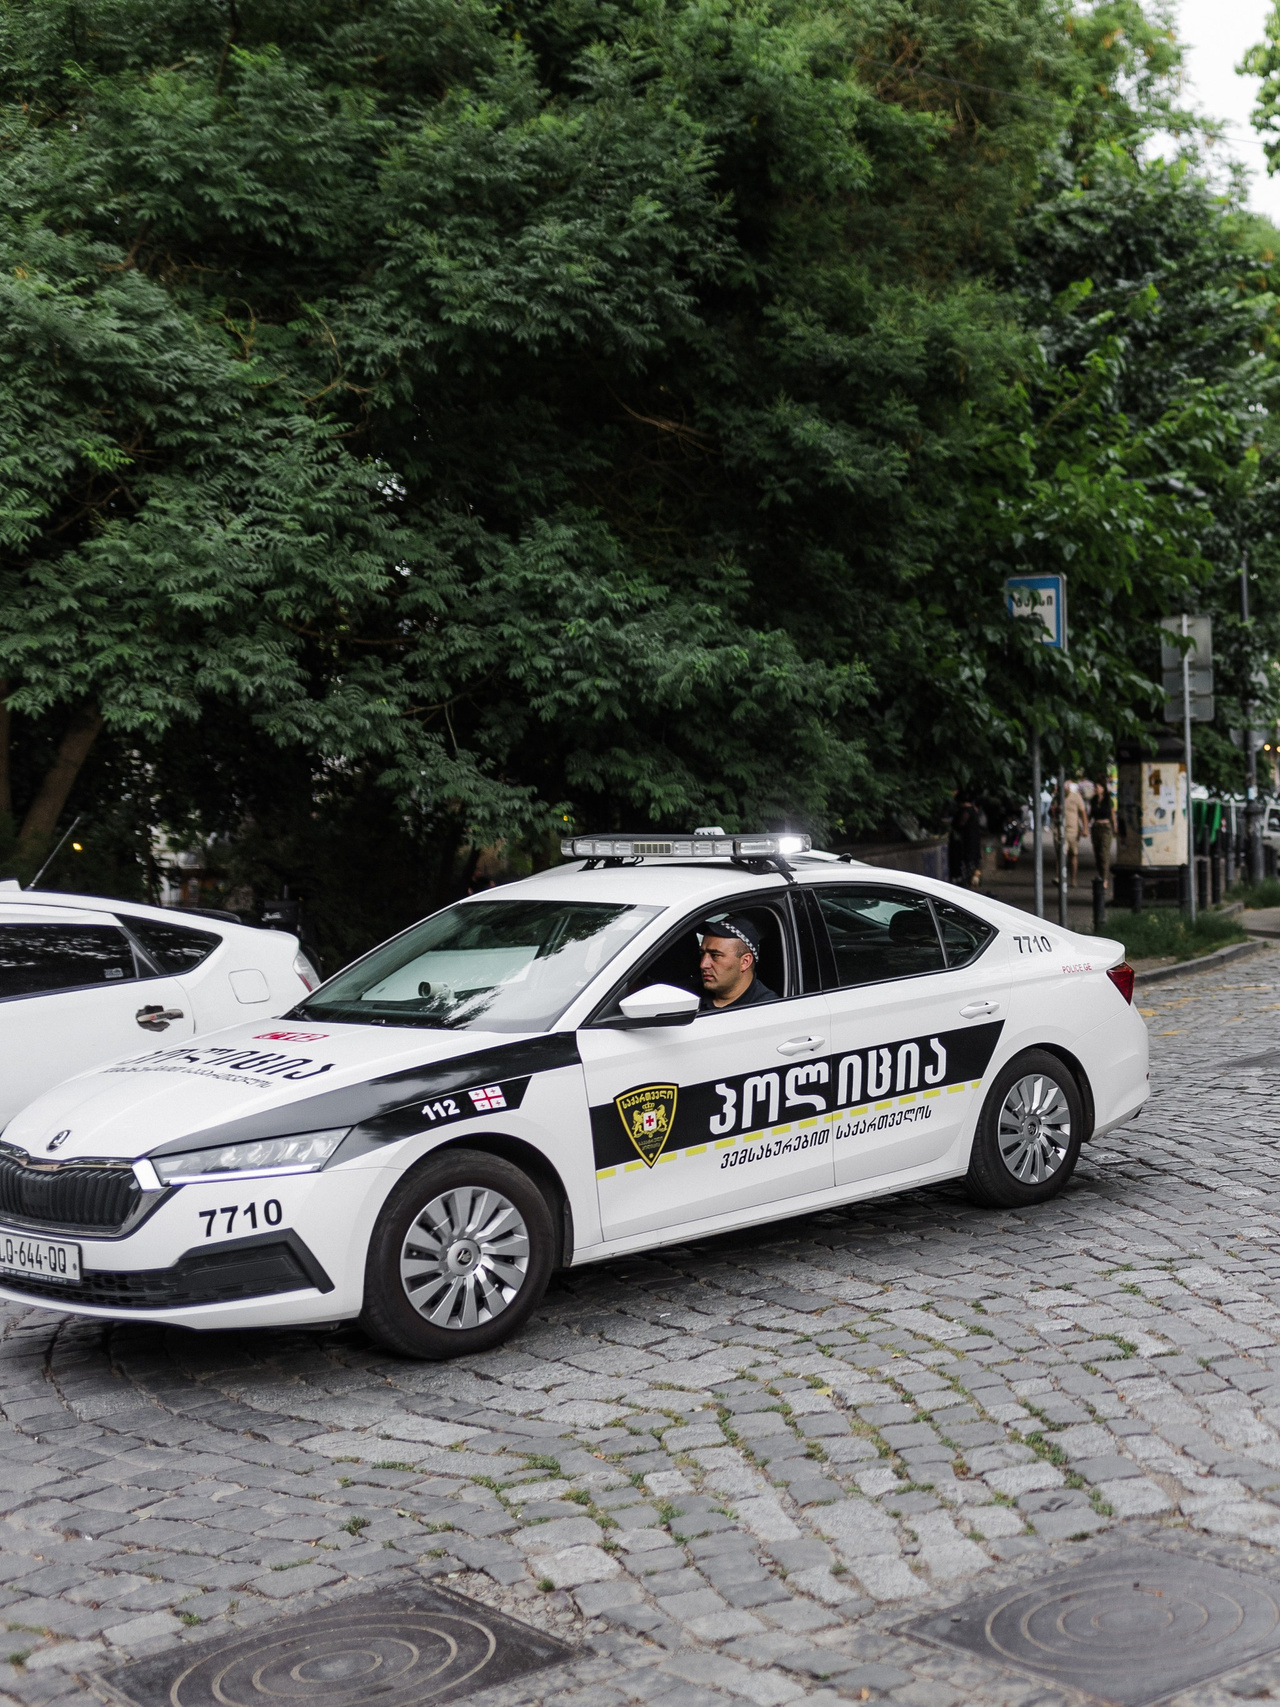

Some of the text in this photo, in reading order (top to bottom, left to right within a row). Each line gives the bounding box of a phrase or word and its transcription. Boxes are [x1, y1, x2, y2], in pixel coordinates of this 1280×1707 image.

[1013, 935, 1052, 954] 7710
[621, 1090, 674, 1109] საქართველო
[709, 1037, 947, 1135] პოლიცია
[421, 1099, 461, 1121] 112
[720, 1104, 932, 1169] ვემსახურებით საქართველოს
[198, 1198, 283, 1237] 7710
